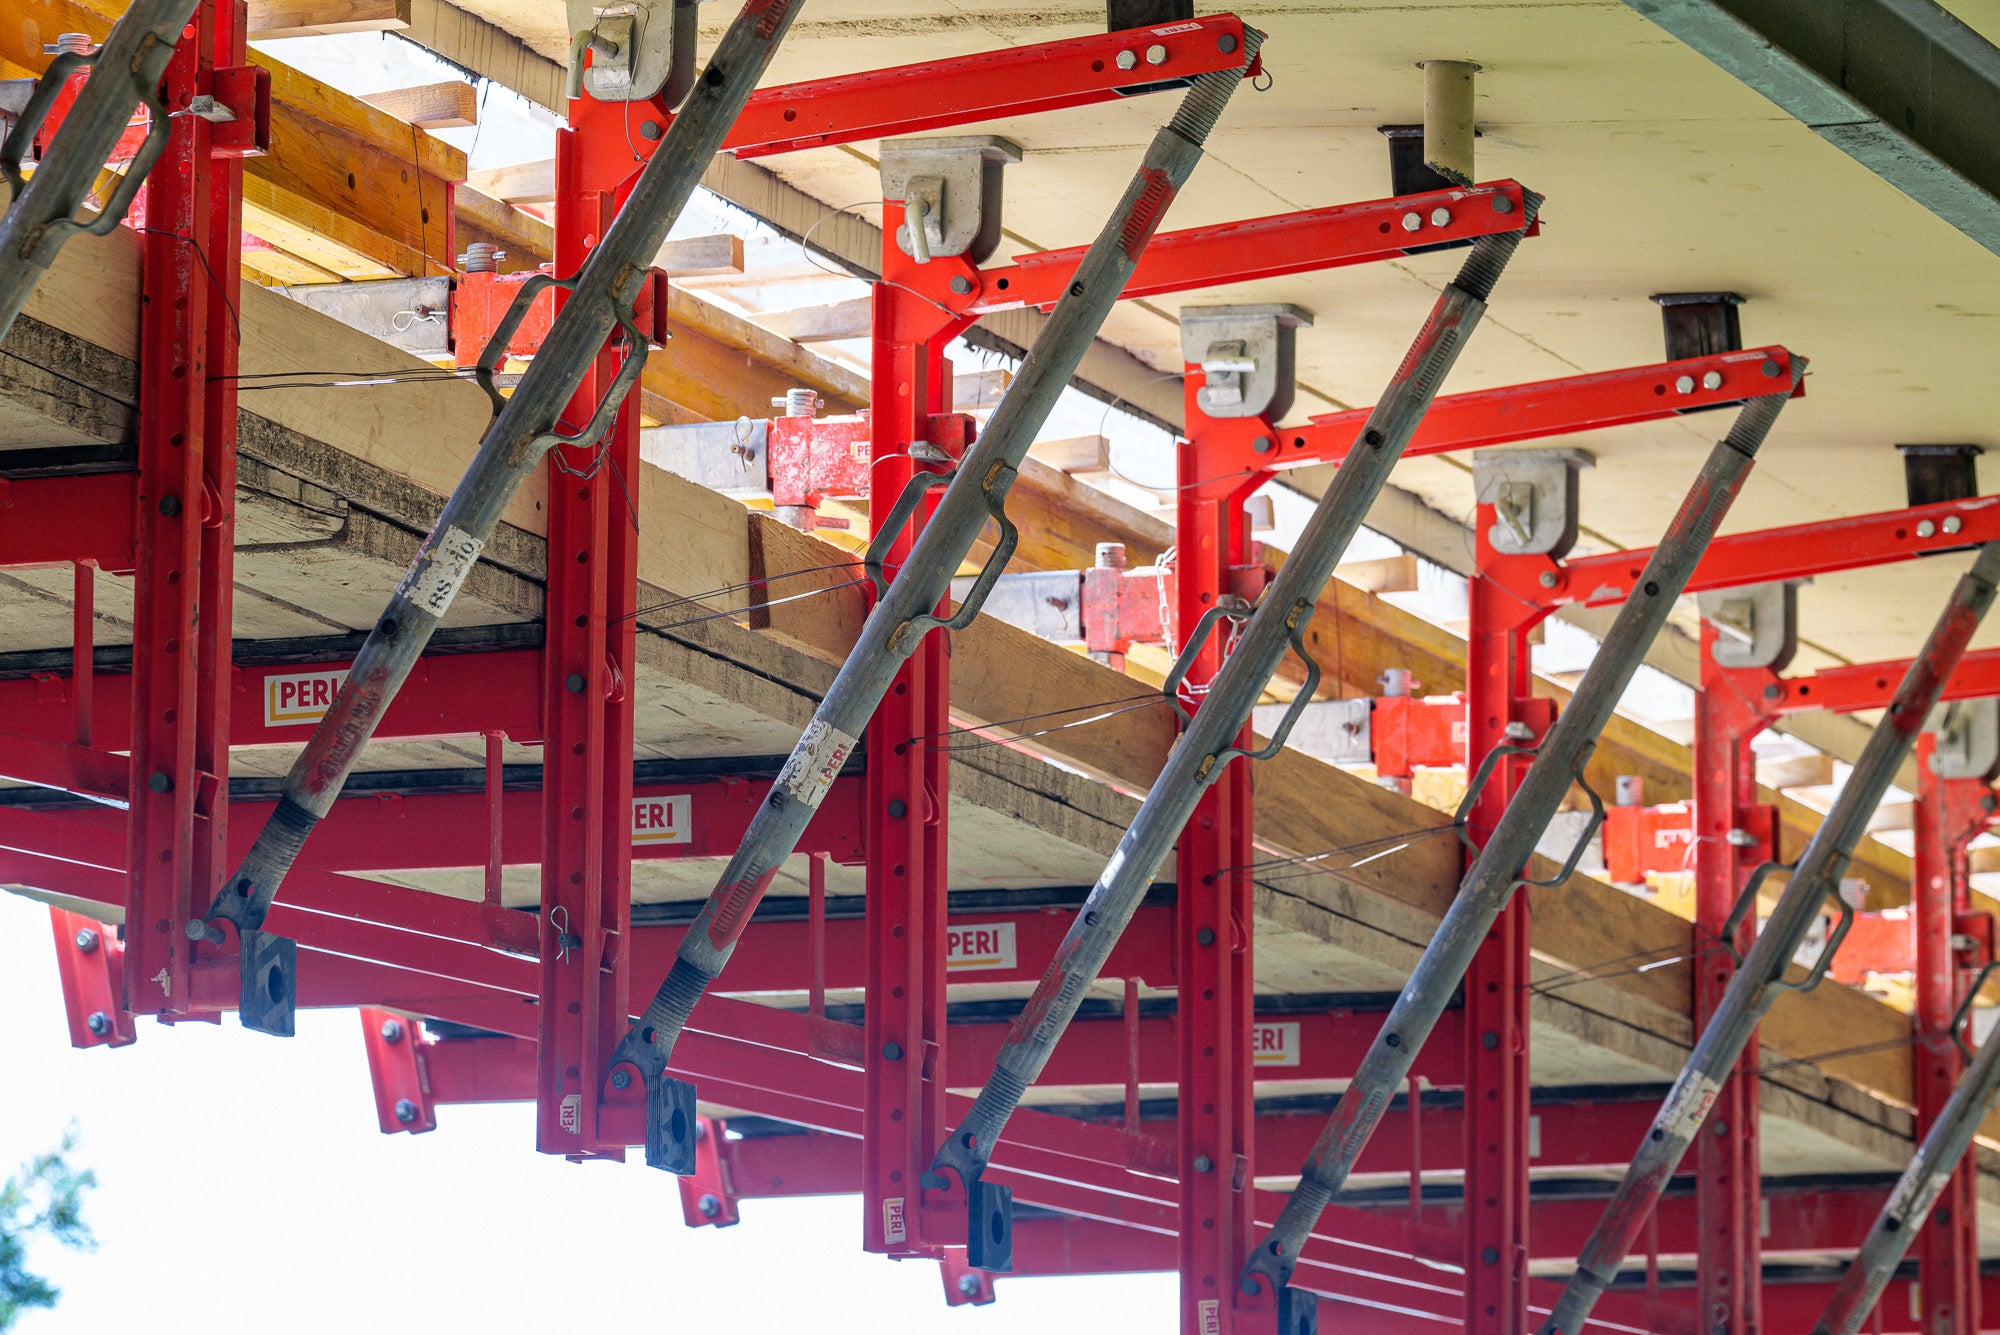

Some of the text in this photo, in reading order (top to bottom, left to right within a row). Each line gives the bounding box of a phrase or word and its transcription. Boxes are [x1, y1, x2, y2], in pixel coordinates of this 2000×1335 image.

[280, 677, 337, 709] PERI
[822, 741, 850, 780] PERI
[632, 802, 673, 829] ERI
[947, 929, 999, 957] PERI
[890, 1205, 903, 1234] PERI
